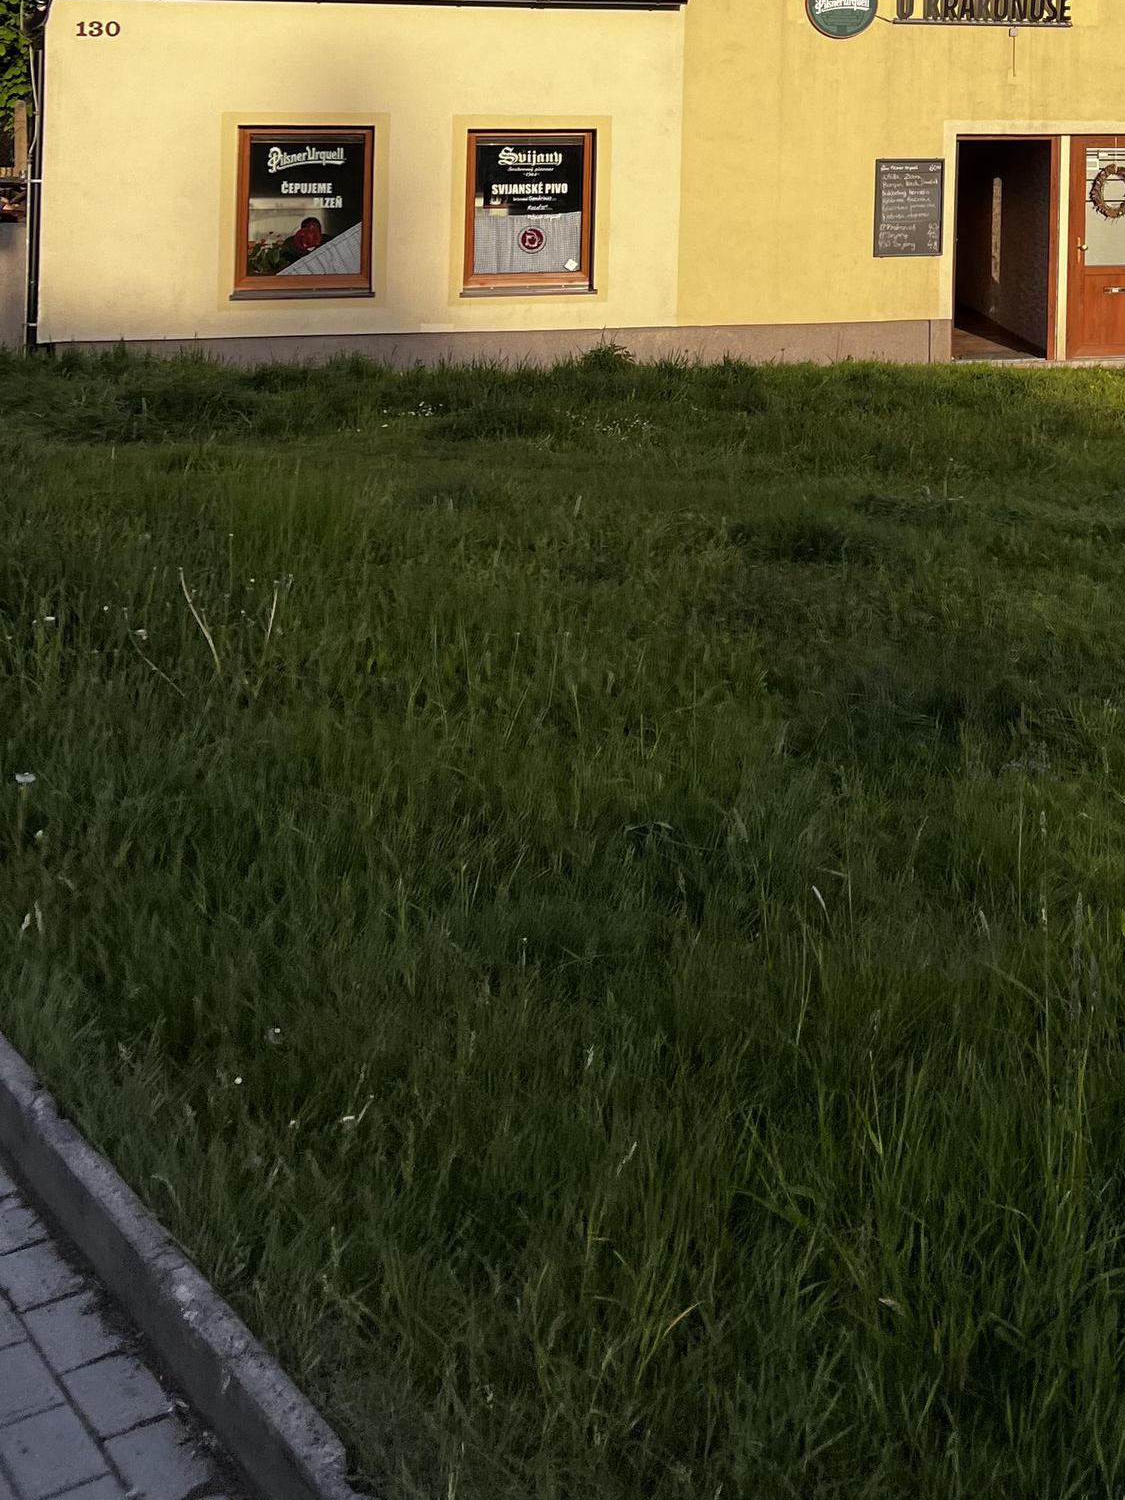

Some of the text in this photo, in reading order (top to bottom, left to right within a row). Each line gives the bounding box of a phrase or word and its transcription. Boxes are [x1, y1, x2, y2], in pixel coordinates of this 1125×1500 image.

[75, 20, 121, 37] 130
[268, 145, 345, 174] Pilsner Urquell
[497, 146, 563, 166] Svijany
[281, 181, 333, 194] ČEPUJEME
[491, 181, 568, 195] SVIJANSKÉ PIVO
[312, 195, 343, 209] PLZEŇ
